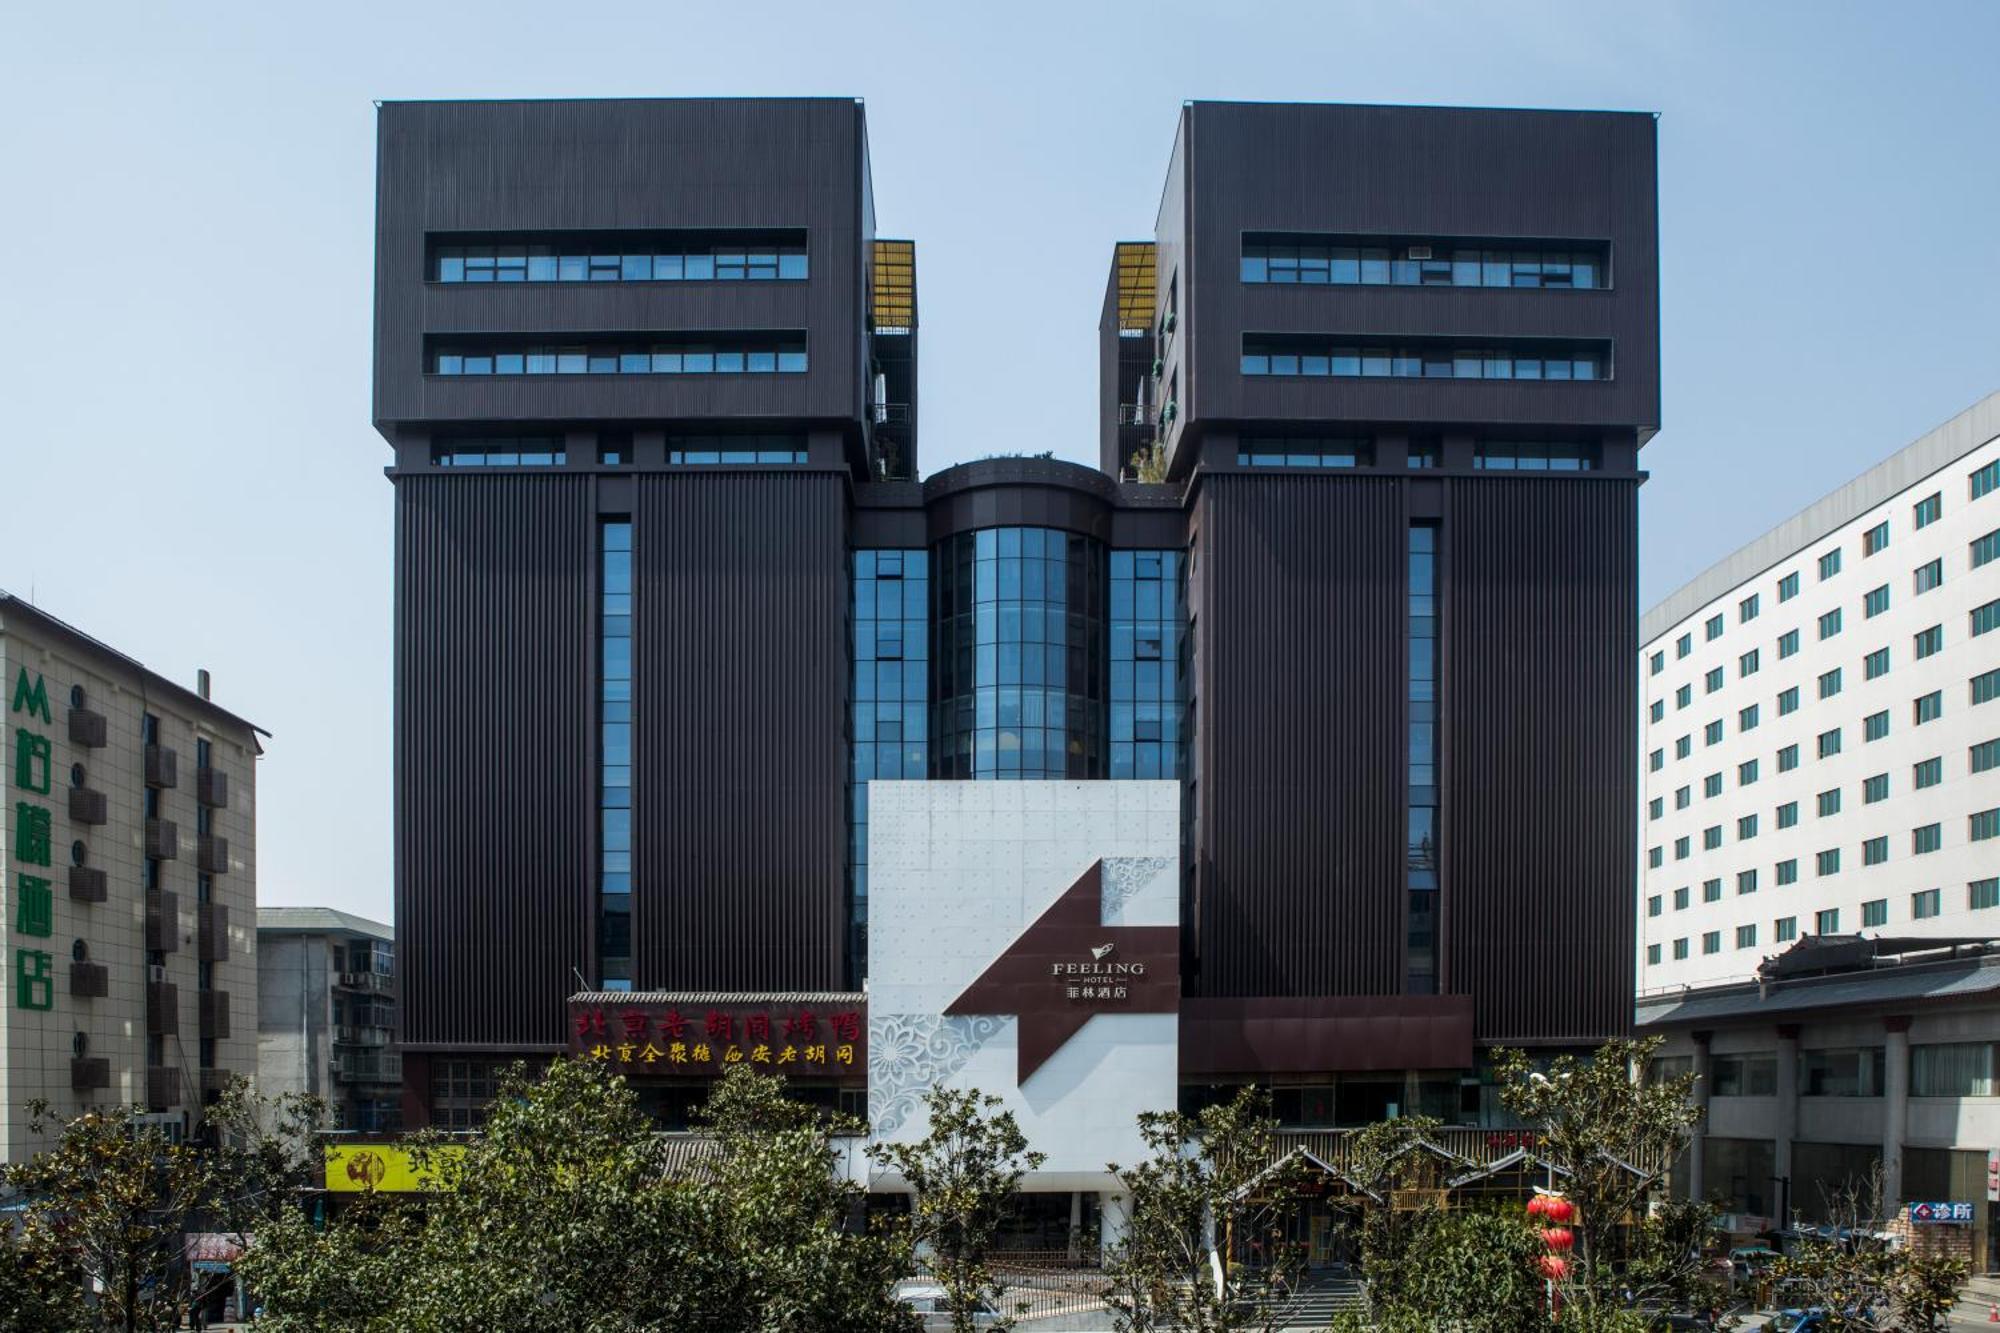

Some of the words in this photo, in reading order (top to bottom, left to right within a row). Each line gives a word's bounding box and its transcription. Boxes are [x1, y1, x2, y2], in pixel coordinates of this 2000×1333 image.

[1050, 962, 1145, 975] FEELING
[1083, 976, 1114, 984] HOTEL
[1066, 986, 1127, 999] 菲林酒店
[1933, 1202, 1973, 1220] 诊所
